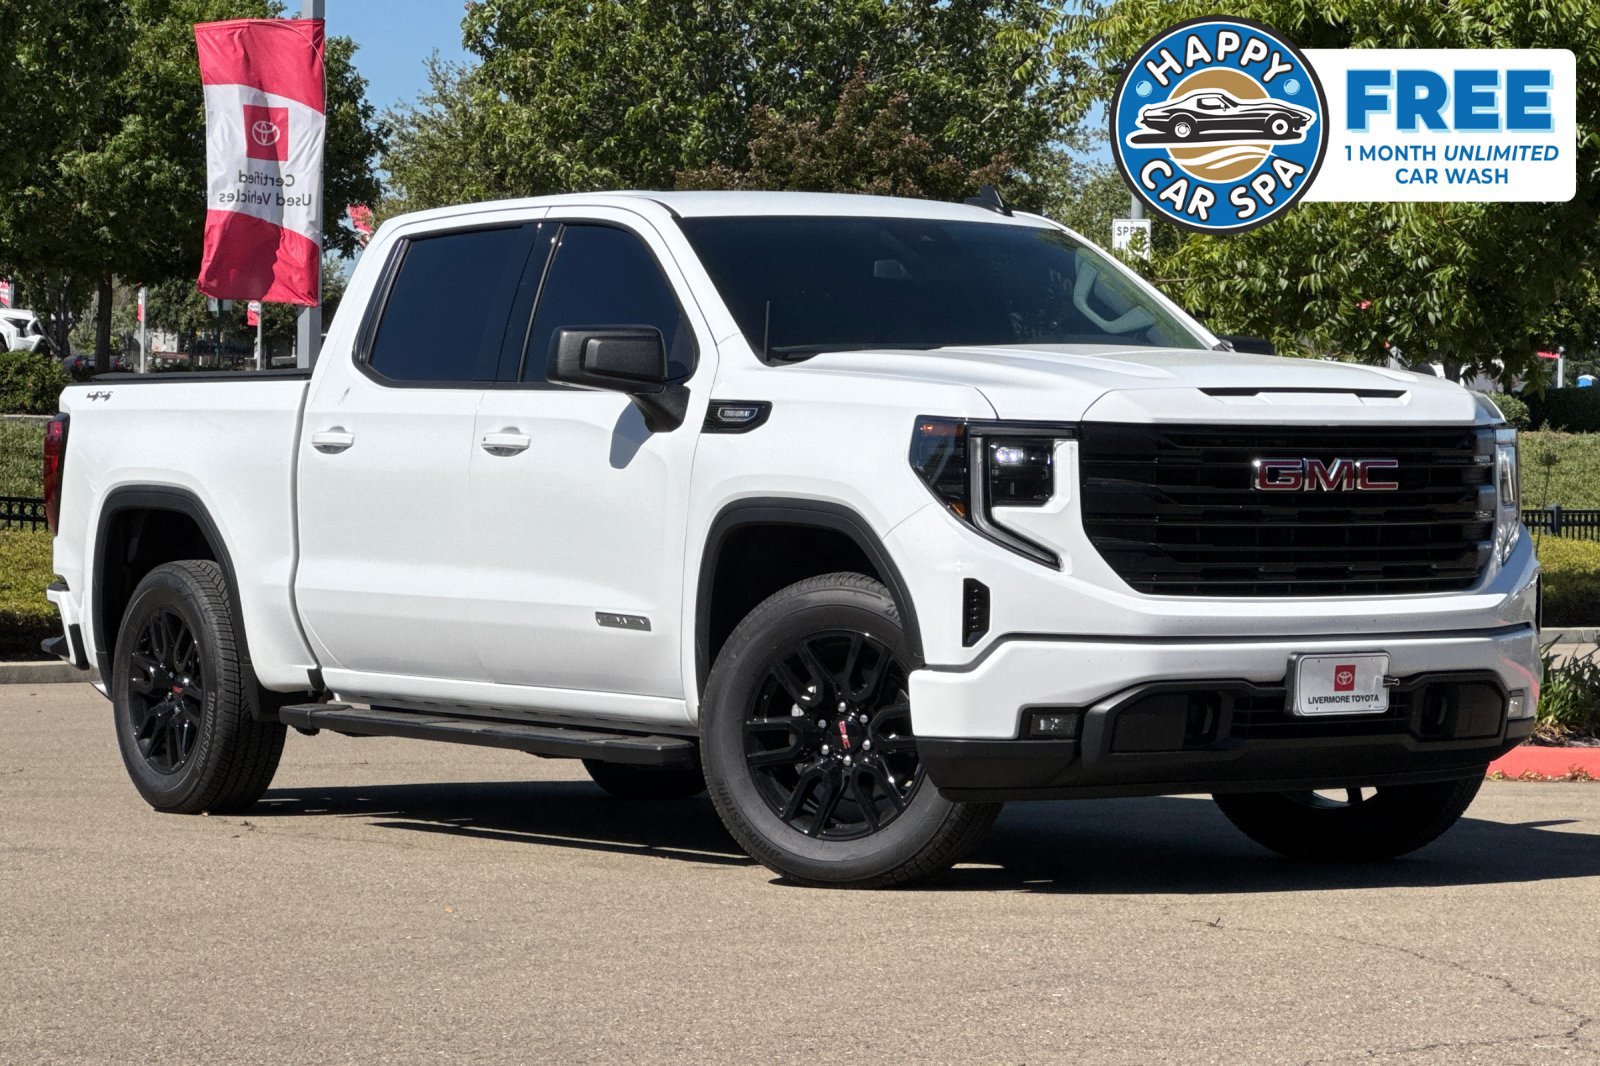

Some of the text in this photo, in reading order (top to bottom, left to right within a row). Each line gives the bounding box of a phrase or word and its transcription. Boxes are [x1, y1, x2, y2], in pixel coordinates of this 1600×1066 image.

[1254, 457, 1399, 491] GMC
[1307, 694, 1379, 705] LIVERMORE TOYOTA
